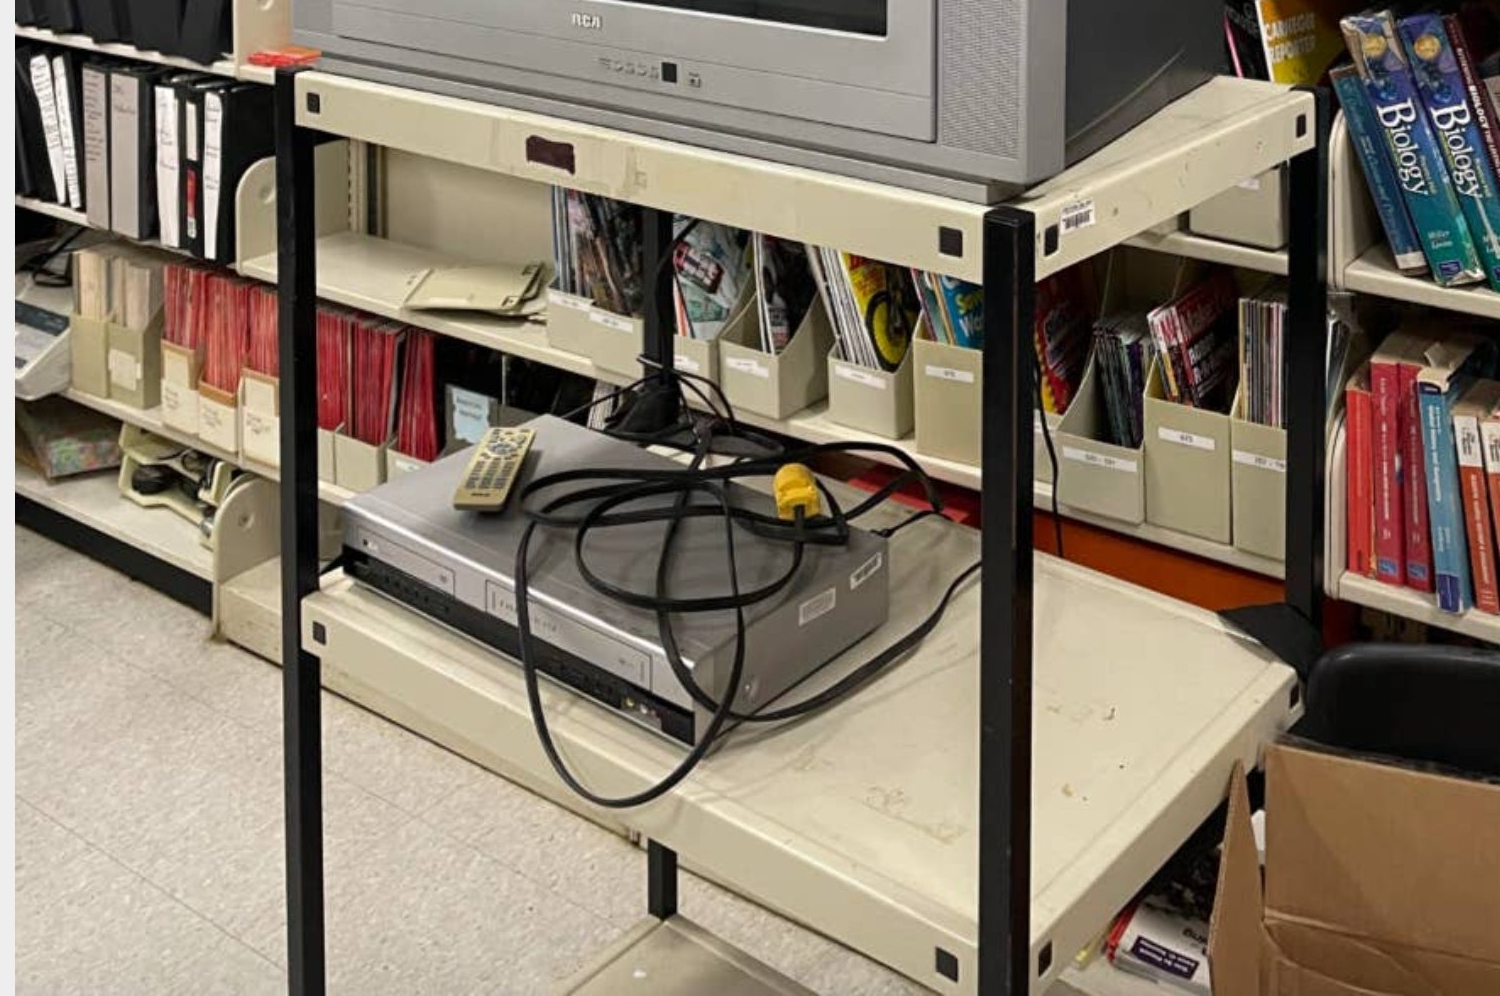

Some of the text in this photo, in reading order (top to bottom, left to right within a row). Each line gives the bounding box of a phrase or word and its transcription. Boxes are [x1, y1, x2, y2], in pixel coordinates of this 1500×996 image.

[571, 12, 603, 30] RCA
[1376, 97, 1429, 196] Biology
[1430, 99, 1483, 199] Biology
